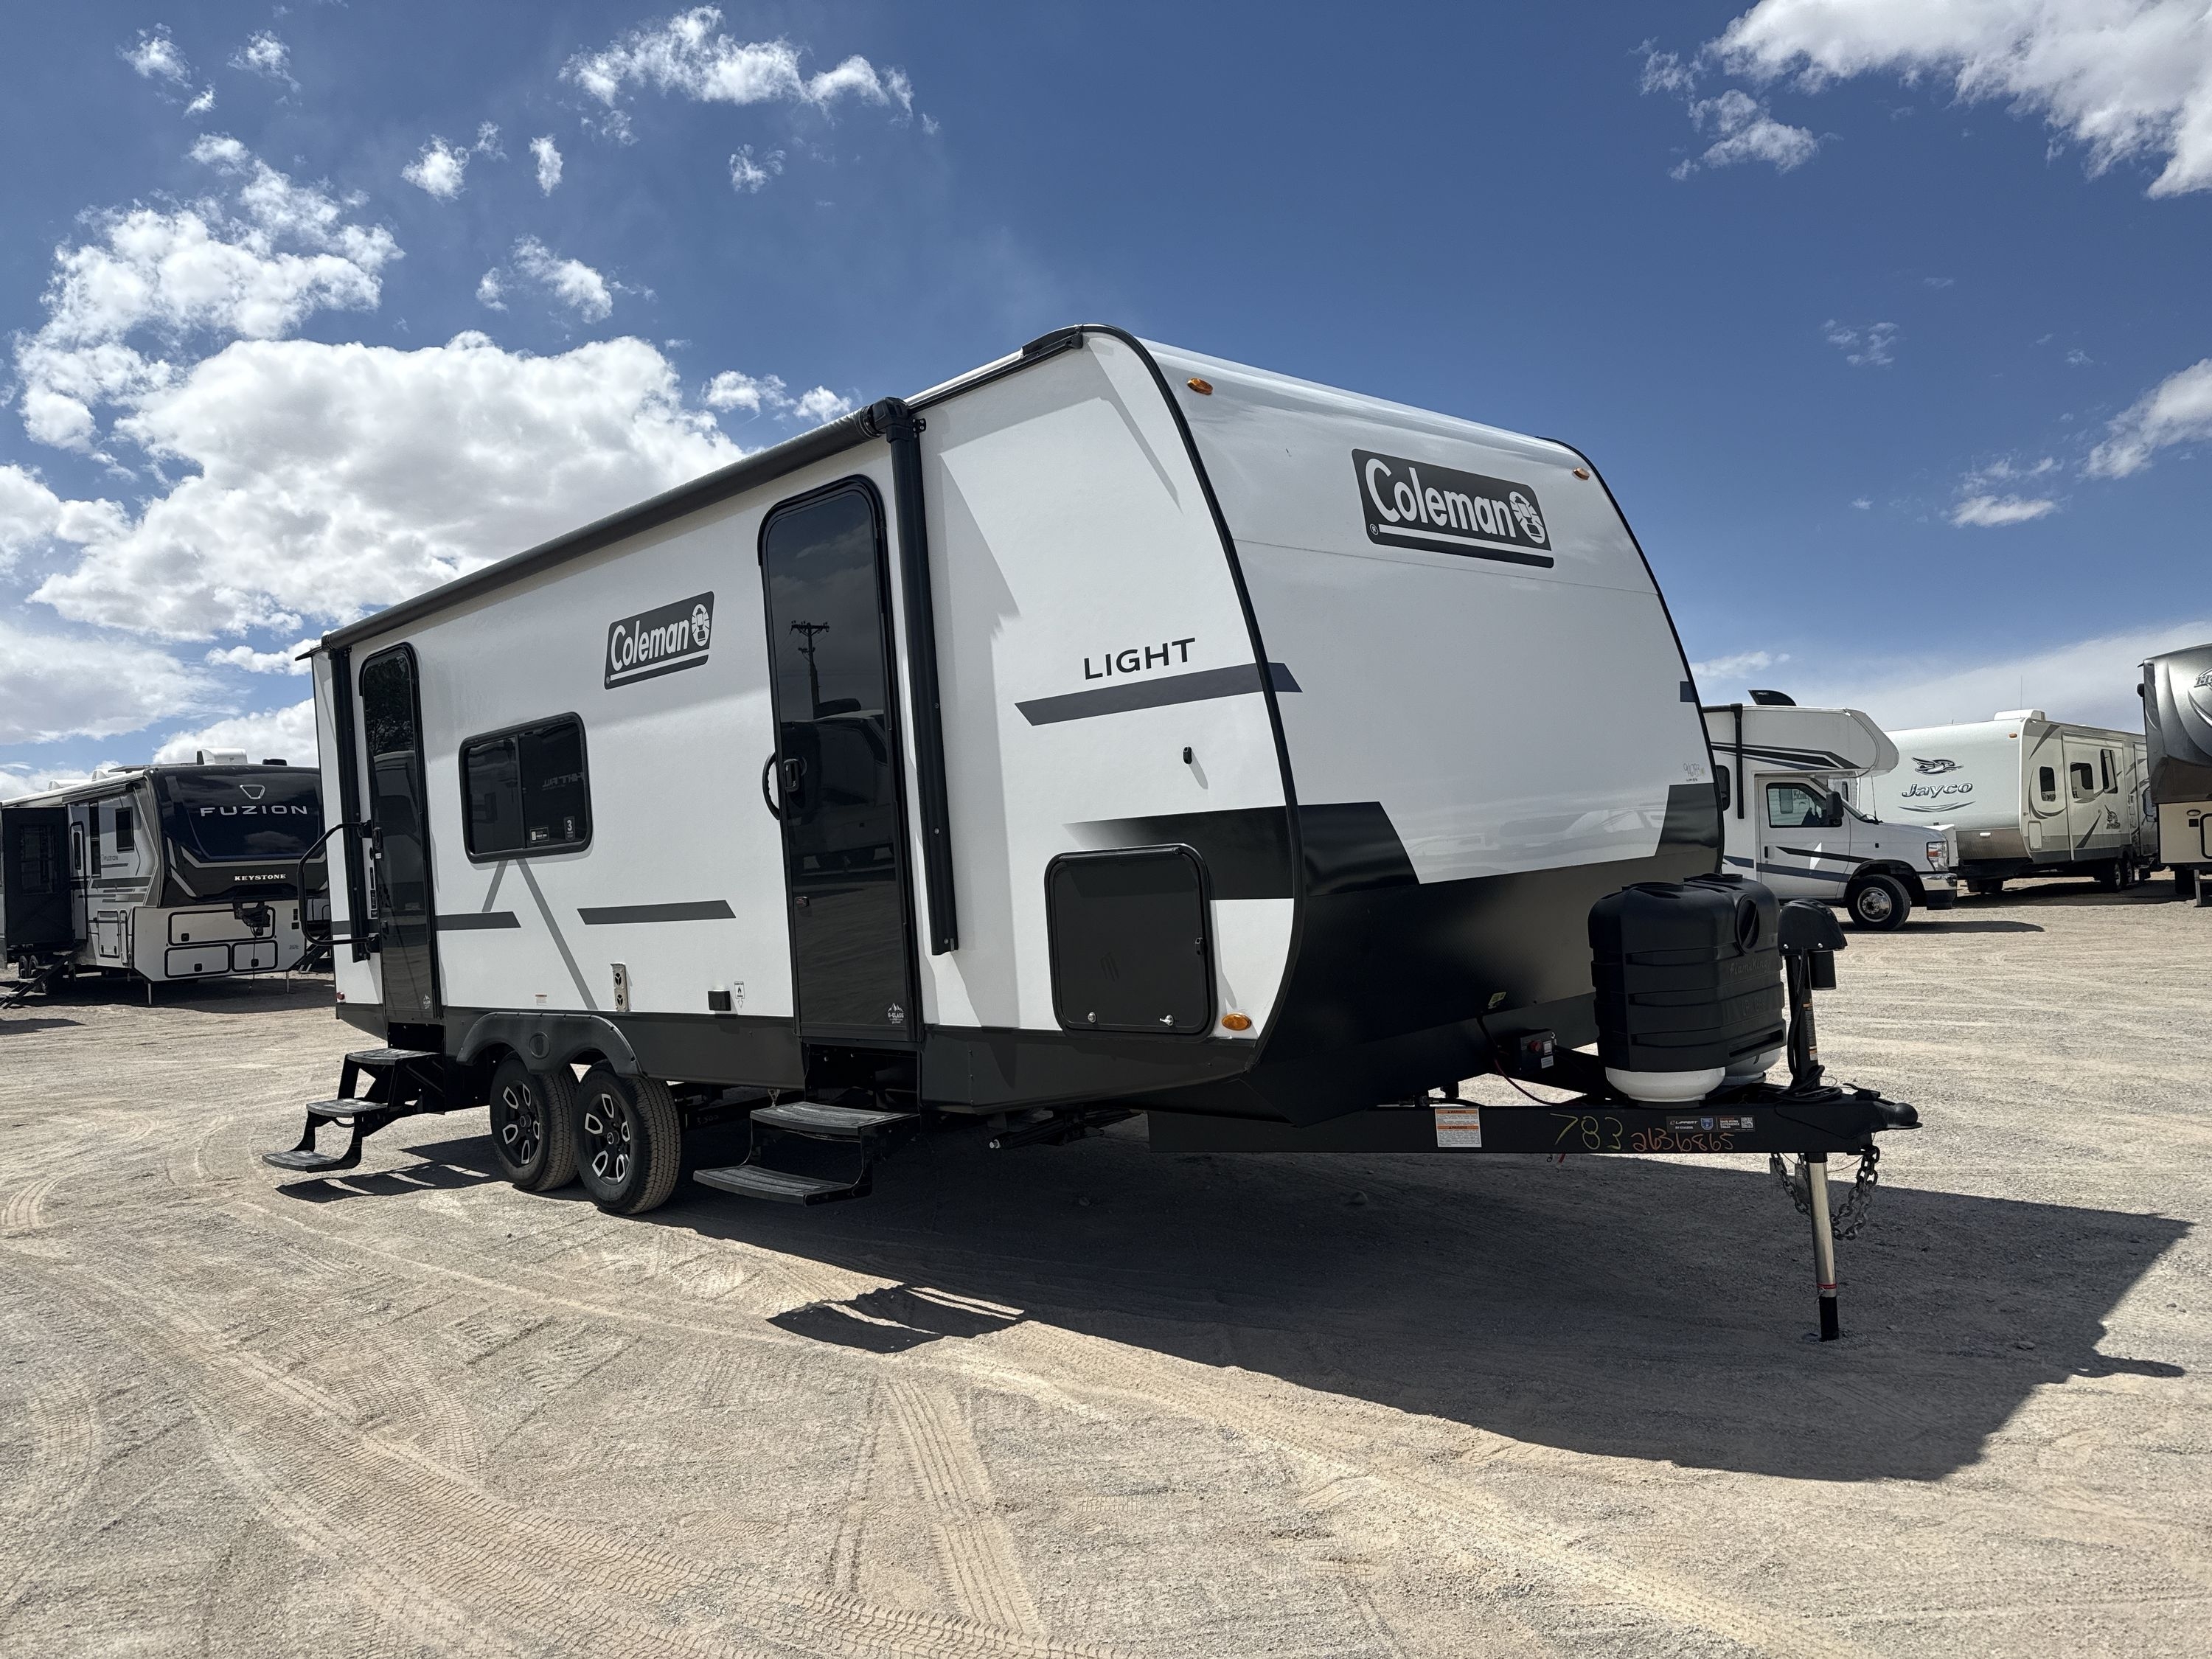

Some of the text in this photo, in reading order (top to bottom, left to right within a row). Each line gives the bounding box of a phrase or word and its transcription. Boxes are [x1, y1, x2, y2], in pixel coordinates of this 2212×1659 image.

[1365, 458, 1516, 538] Coleman
[611, 619, 689, 671] Coleman
[1084, 637, 1196, 680] LIGHT
[200, 805, 308, 817] FUZION
[1902, 783, 1973, 799] Jayco
[1550, 1113, 1623, 1150] 783
